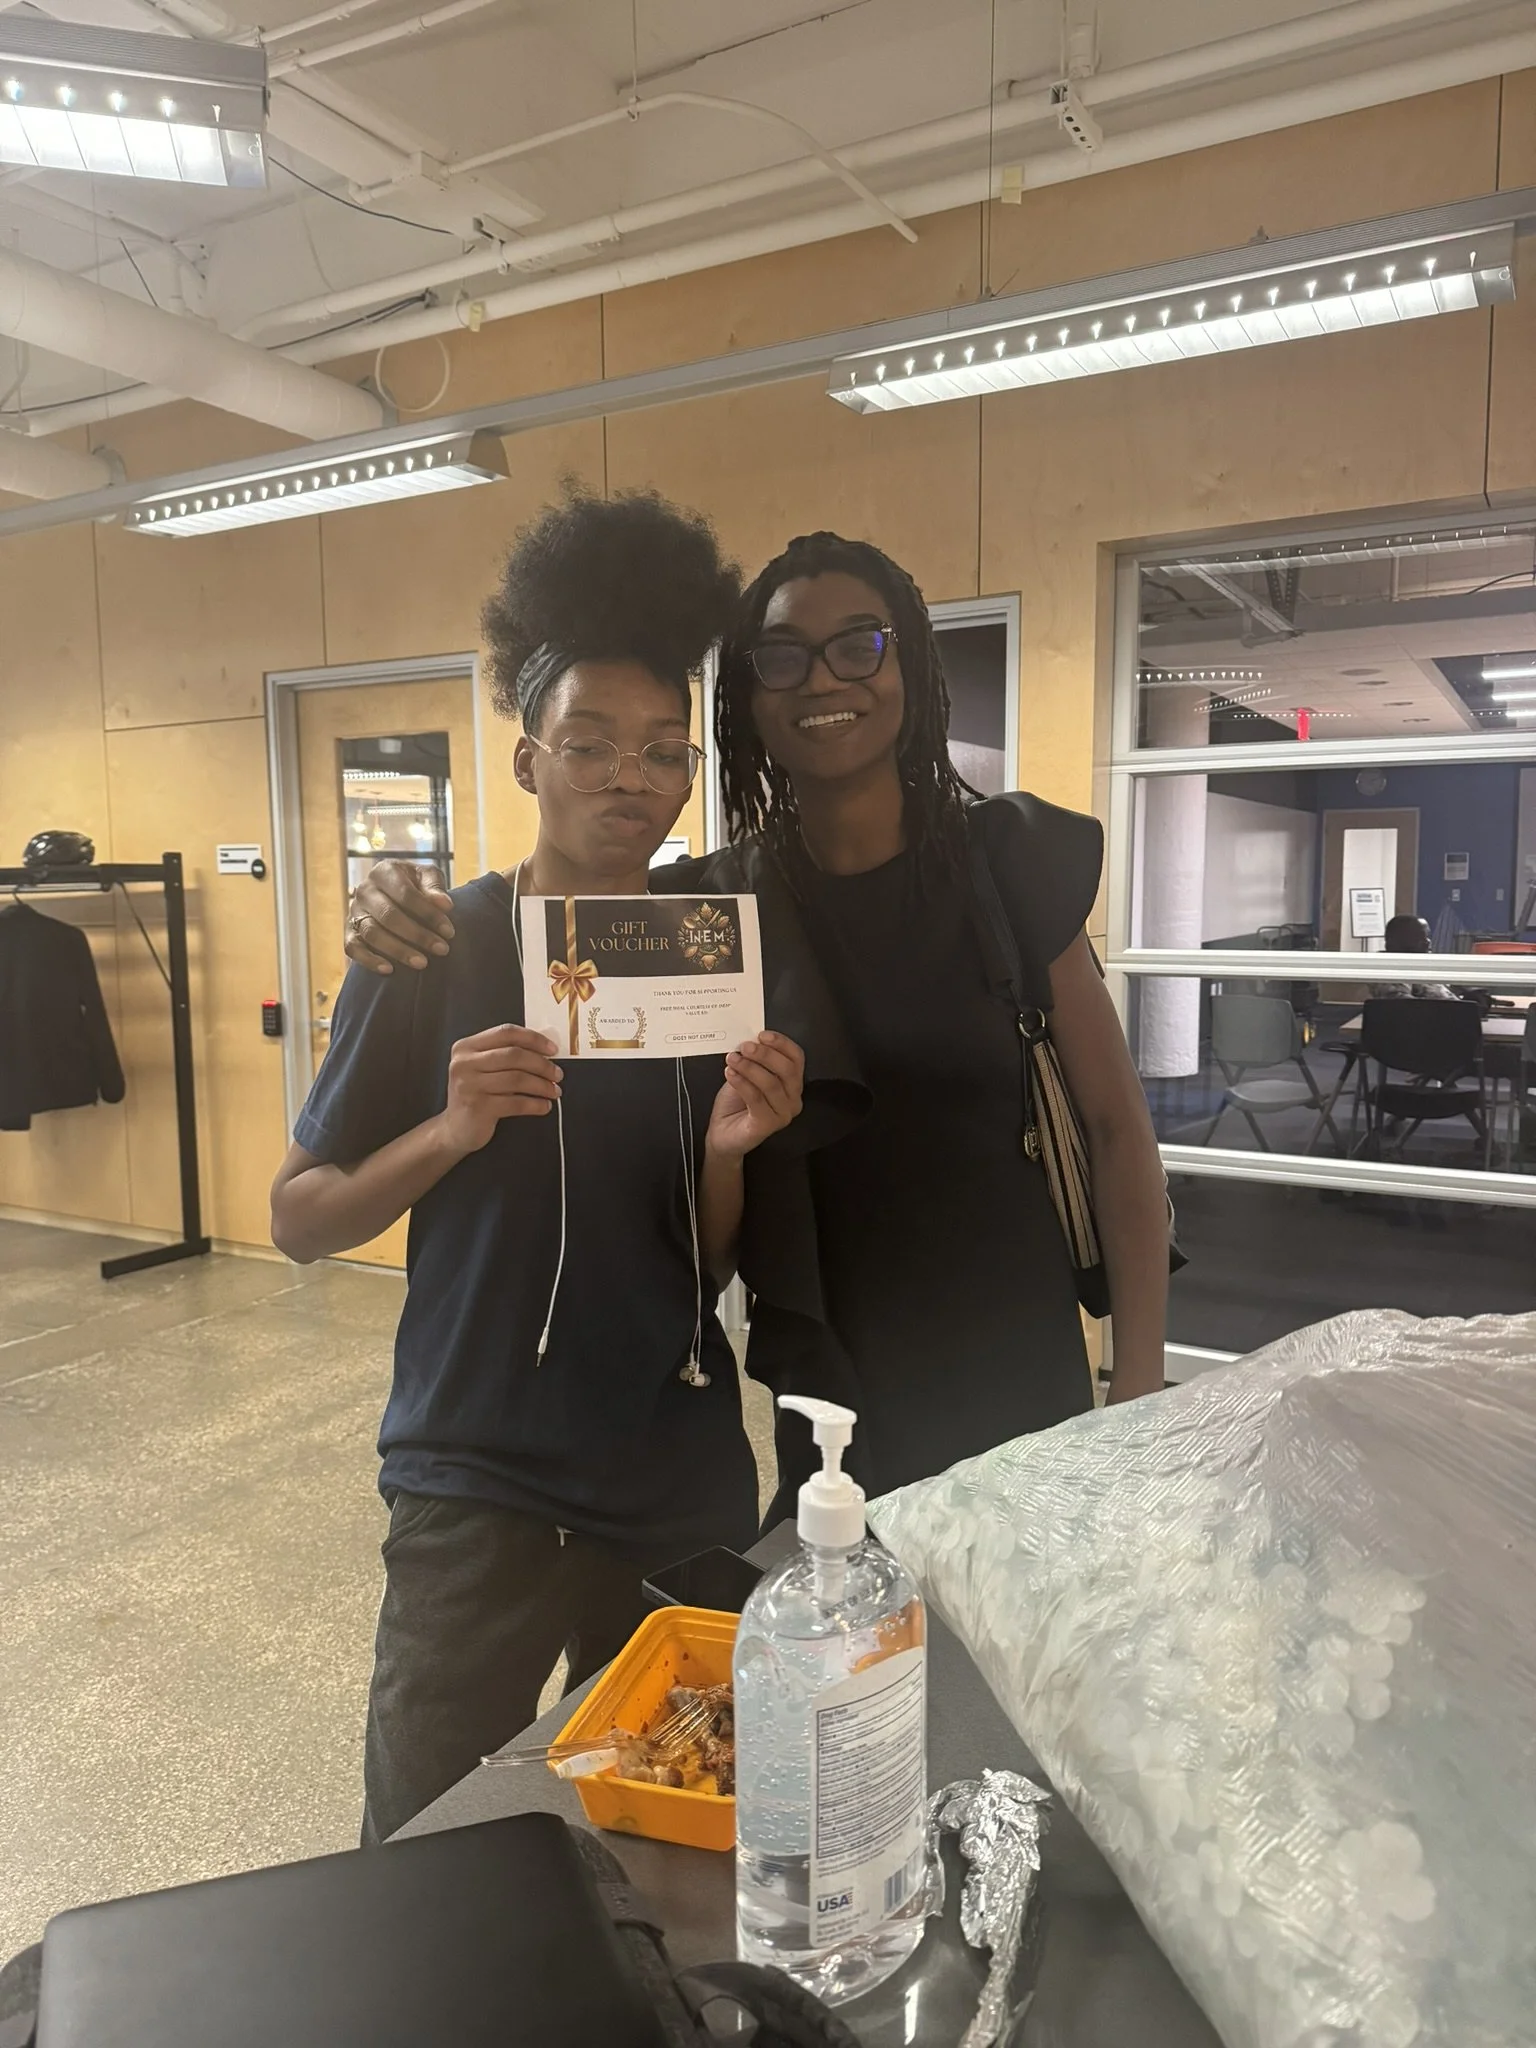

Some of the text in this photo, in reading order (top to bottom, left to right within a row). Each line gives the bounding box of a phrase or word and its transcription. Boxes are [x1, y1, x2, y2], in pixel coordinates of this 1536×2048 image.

[611, 921, 648, 935] GIFT
[589, 937, 670, 951] VOUCHER
[817, 1894, 849, 1912] USA
